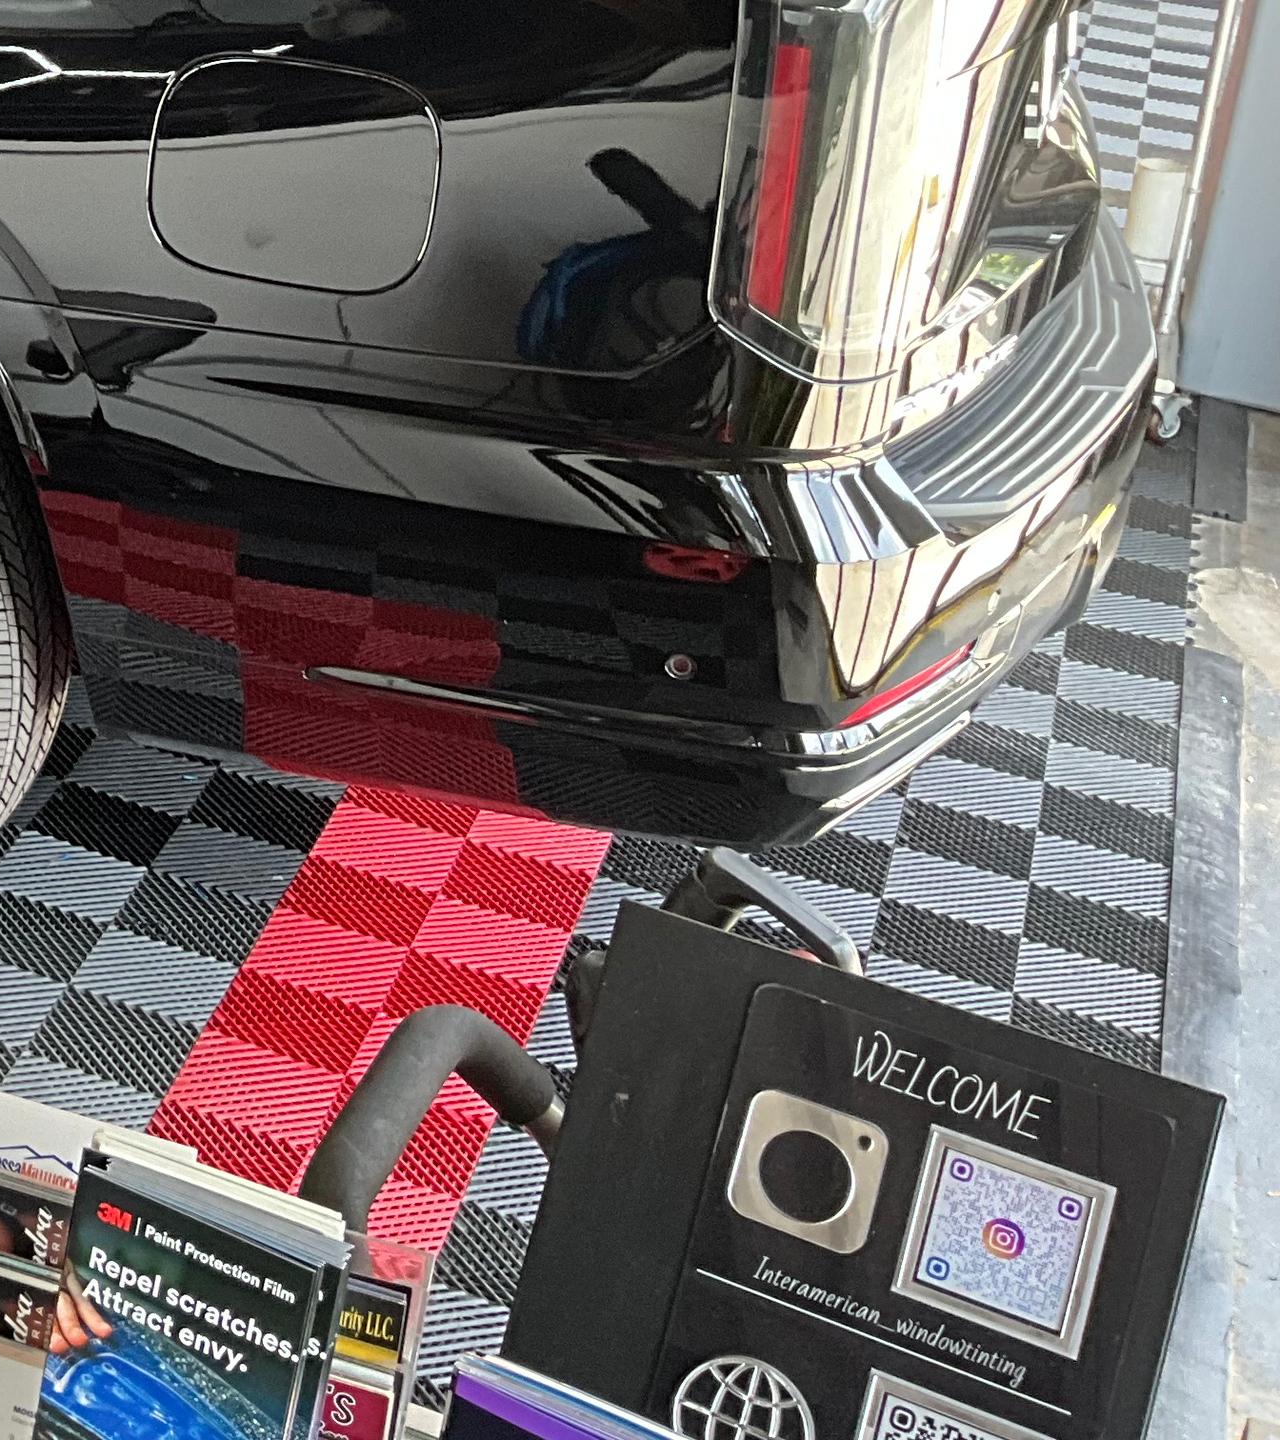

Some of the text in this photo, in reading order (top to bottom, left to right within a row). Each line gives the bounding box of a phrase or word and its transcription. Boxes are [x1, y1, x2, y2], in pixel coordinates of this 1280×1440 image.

[852, 1029, 1053, 1140] WELCOME
[88, 1246, 300, 1363] Repel scratches.
[96, 1202, 296, 1305] 3M Paint Protection Film
[81, 1277, 175, 1338] Attract
[178, 1325, 249, 1373] envy.
[365, 1311, 395, 1343] LLC.
[752, 1255, 1027, 1389] Interamerican_windowtinting
